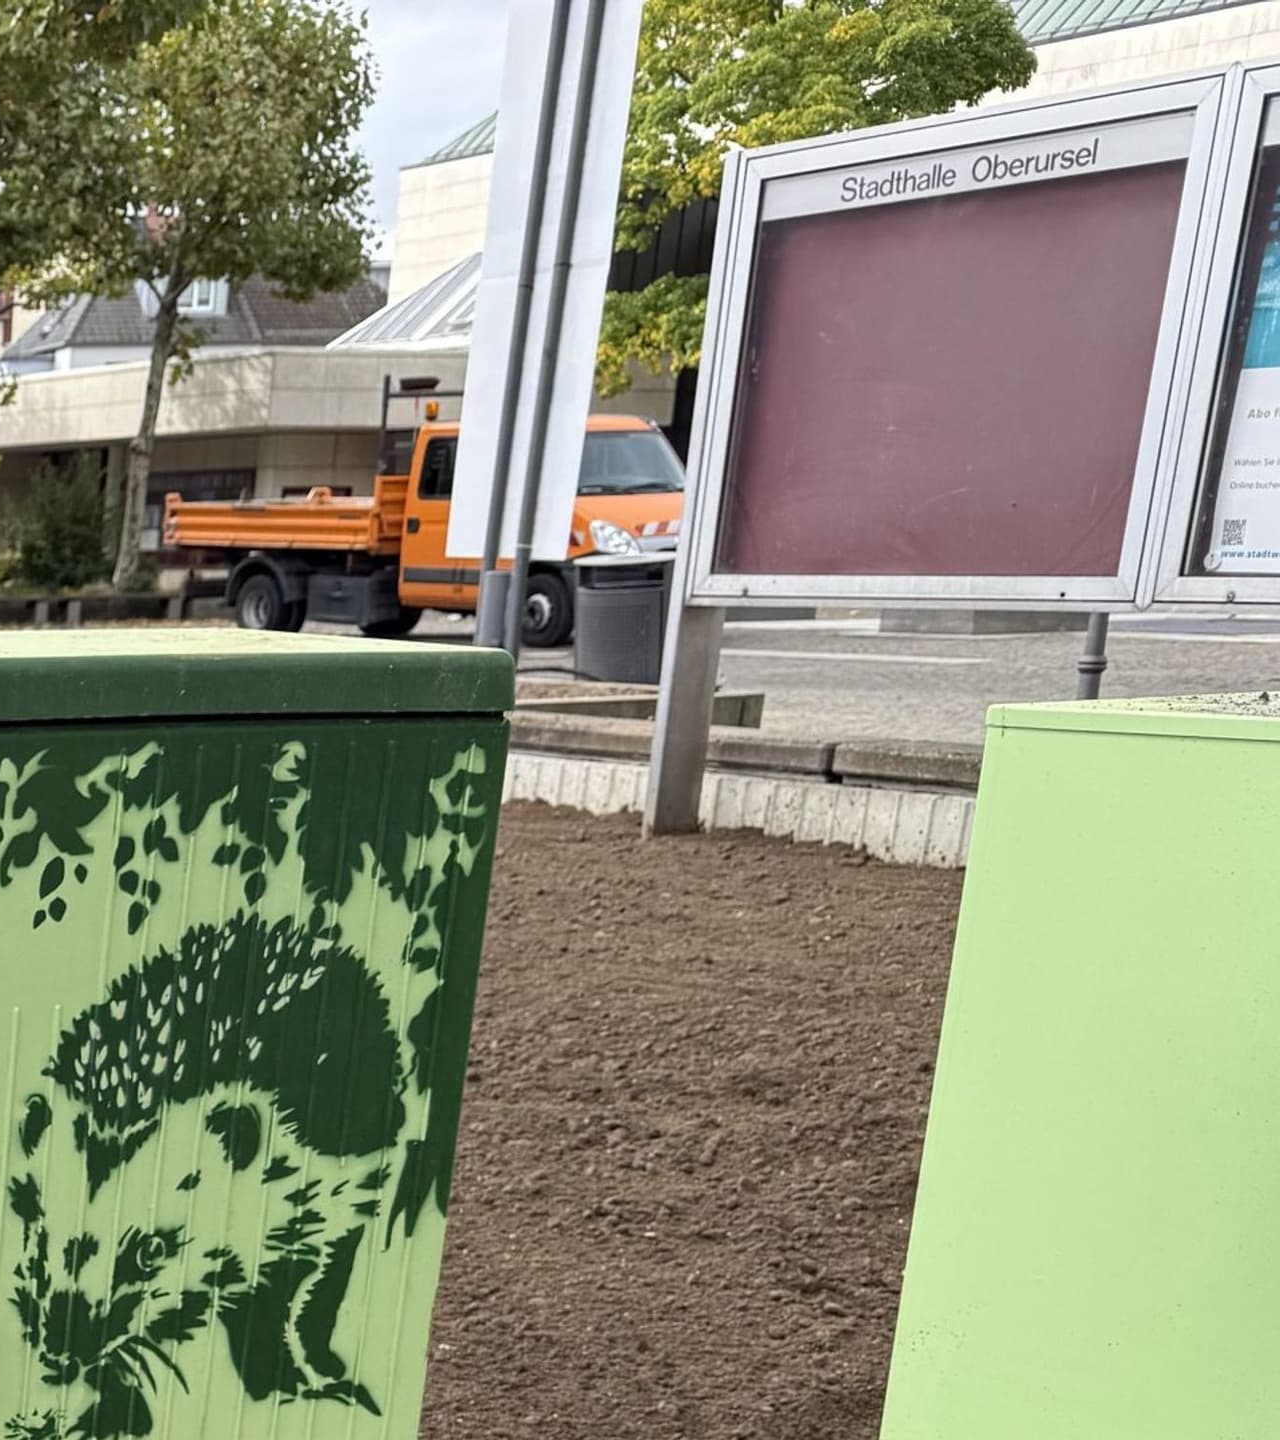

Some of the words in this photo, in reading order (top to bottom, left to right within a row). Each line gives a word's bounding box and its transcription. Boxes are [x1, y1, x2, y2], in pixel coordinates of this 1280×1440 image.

[840, 163, 957, 203] Stadthalle
[971, 137, 1100, 184] Oberursel
[1247, 408, 1271, 419] Abo
